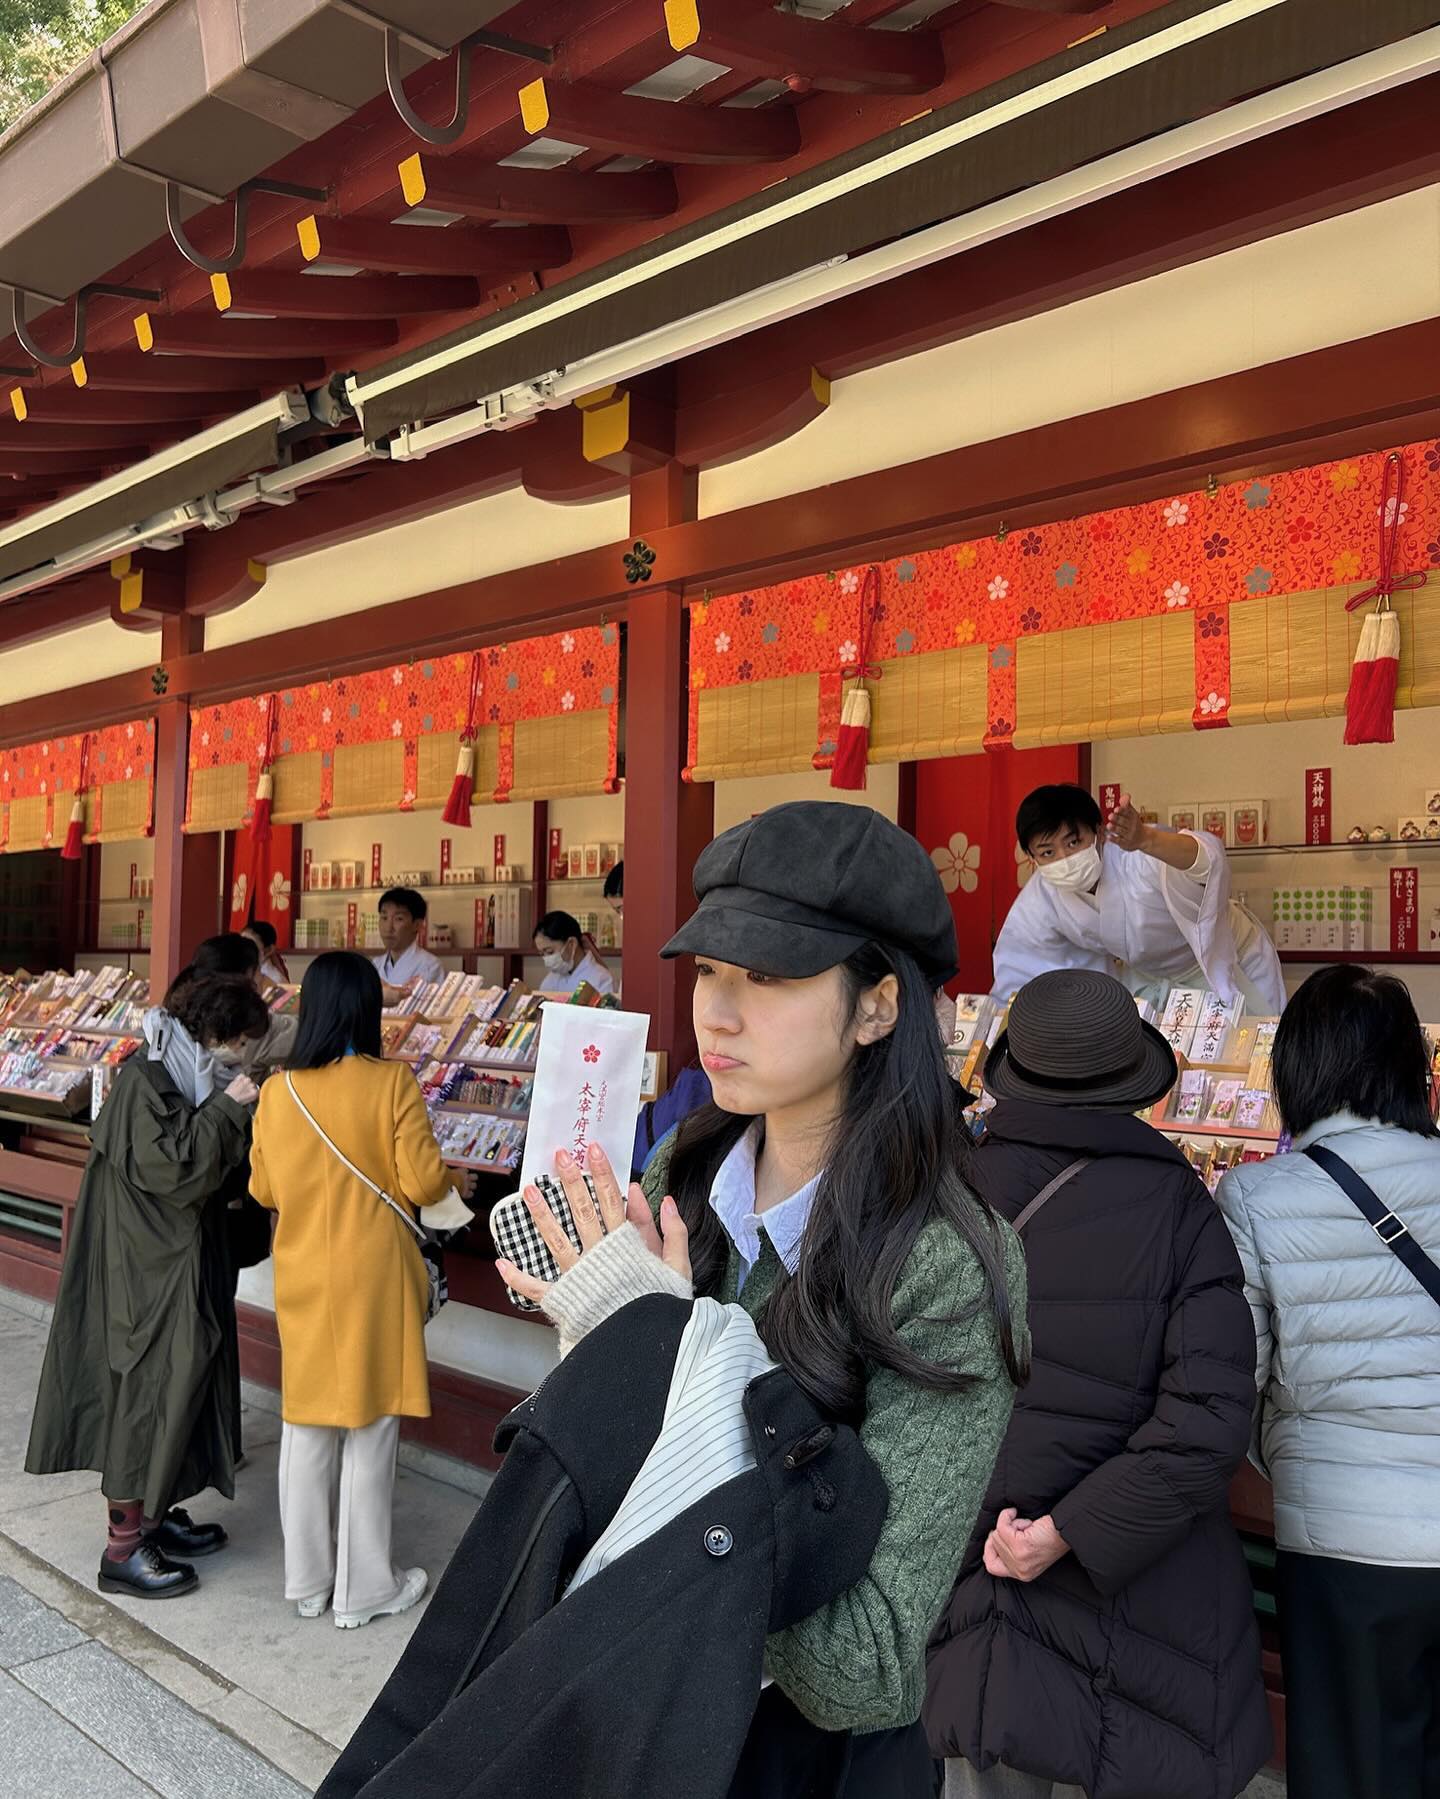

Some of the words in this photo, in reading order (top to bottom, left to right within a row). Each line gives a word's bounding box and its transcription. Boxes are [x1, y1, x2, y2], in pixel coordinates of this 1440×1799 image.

[1312, 771, 1325, 808] 天神鈴
[1405, 870, 1415, 914] 天神さまの
[570, 1081, 596, 1170] 太宰府天満
